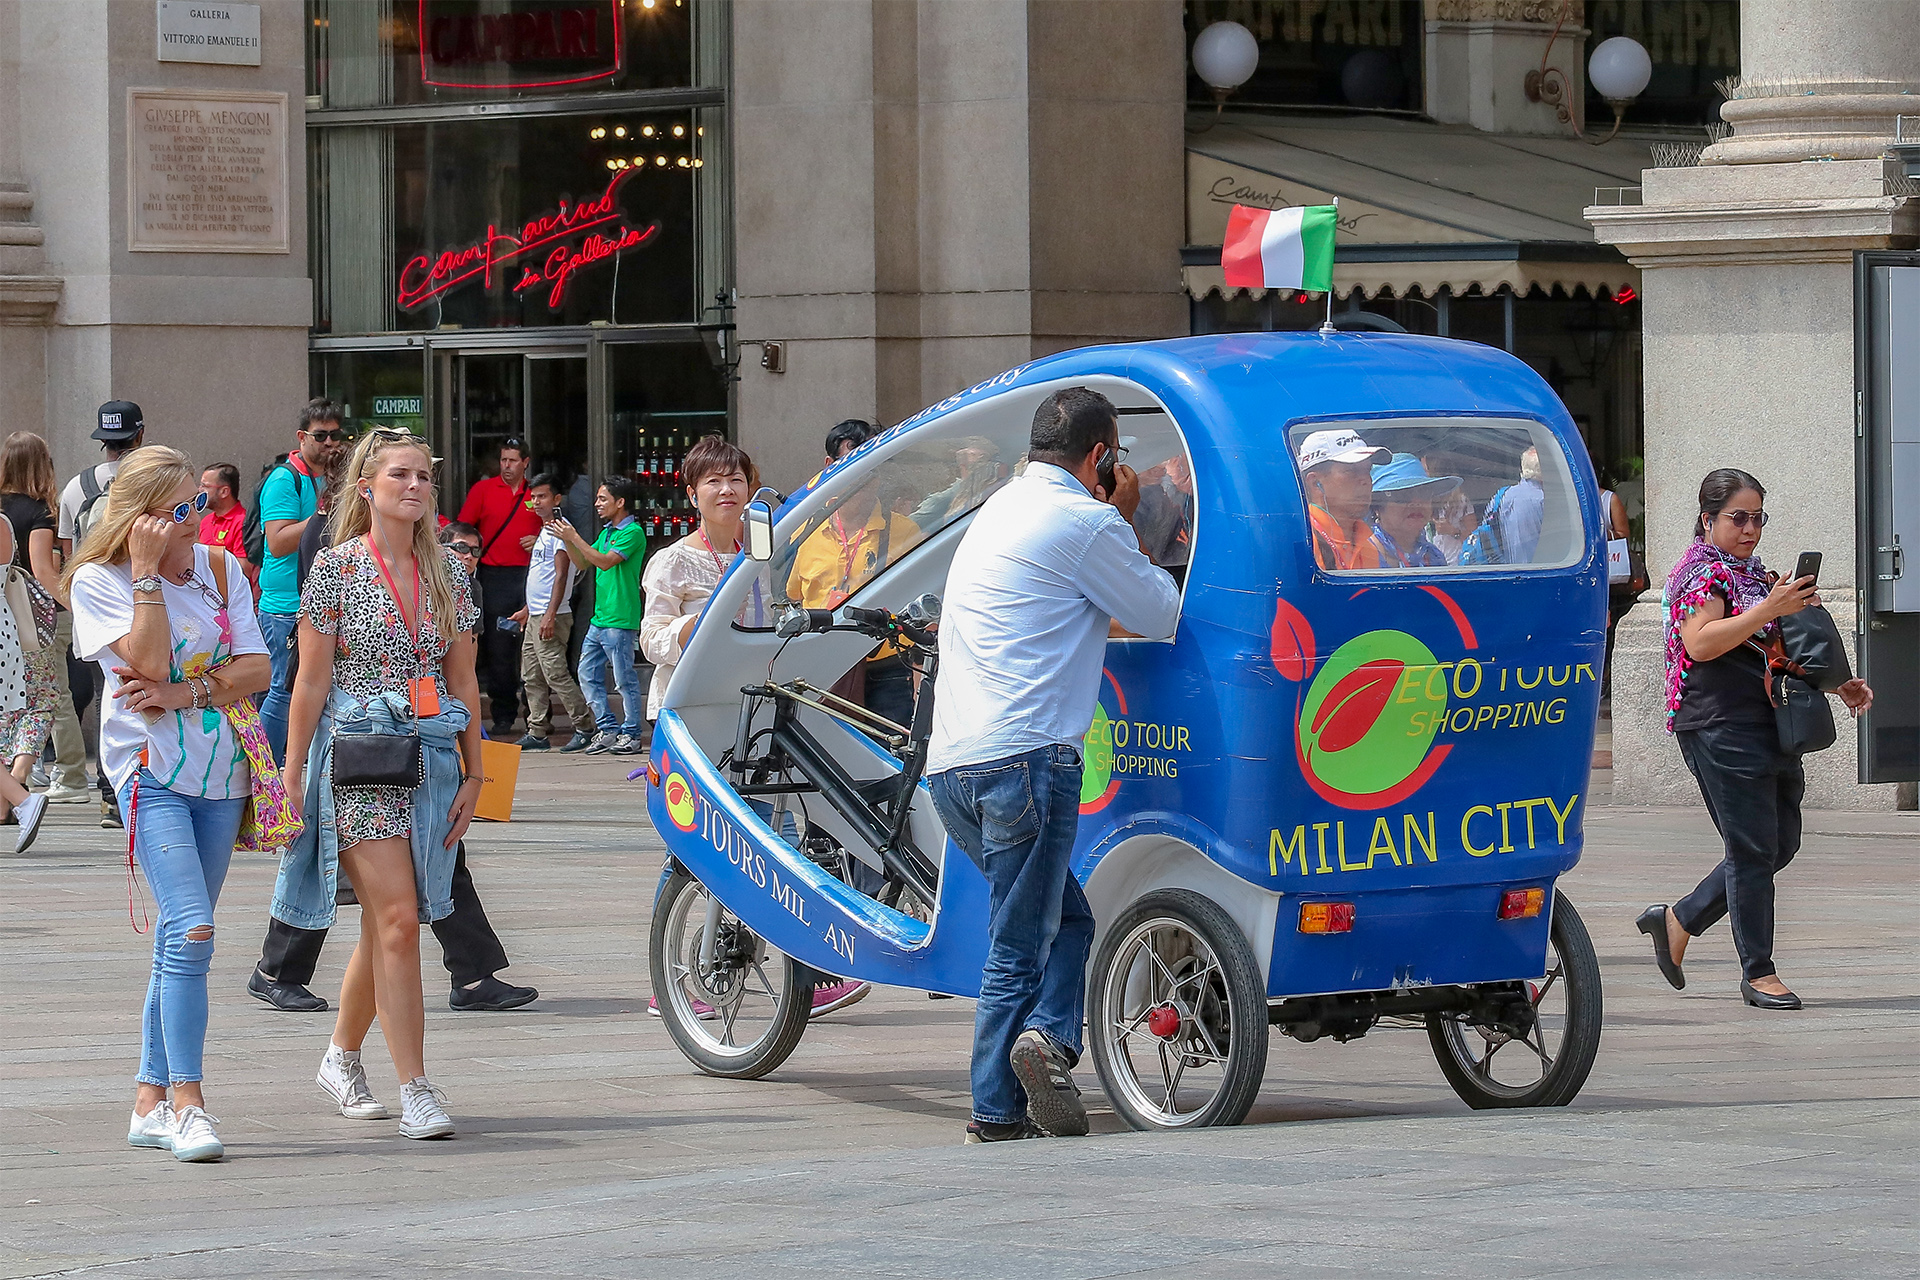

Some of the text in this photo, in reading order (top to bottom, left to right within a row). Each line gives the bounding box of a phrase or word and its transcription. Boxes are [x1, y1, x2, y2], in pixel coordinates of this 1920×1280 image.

[190, 9, 230, 20] GALLERIA
[163, 33, 258, 47] VITTORIO EMANUELE II
[430, 8, 600, 65] CAMPARI
[145, 108, 270, 126] GIVSEPPE MENGONI
[398, 164, 637, 303] Camparino
[513, 224, 656, 308] in Galleria
[375, 399, 420, 414] CAMPARI
[1395, 657, 1483, 704] ECO
[1087, 719, 1192, 752] ECO TOUR
[1406, 698, 1568, 737] SHOPPING
[1095, 752, 1178, 778] SHOPPING
[698, 794, 767, 889] TOURS
[1269, 794, 1579, 877] MILAN CITY
